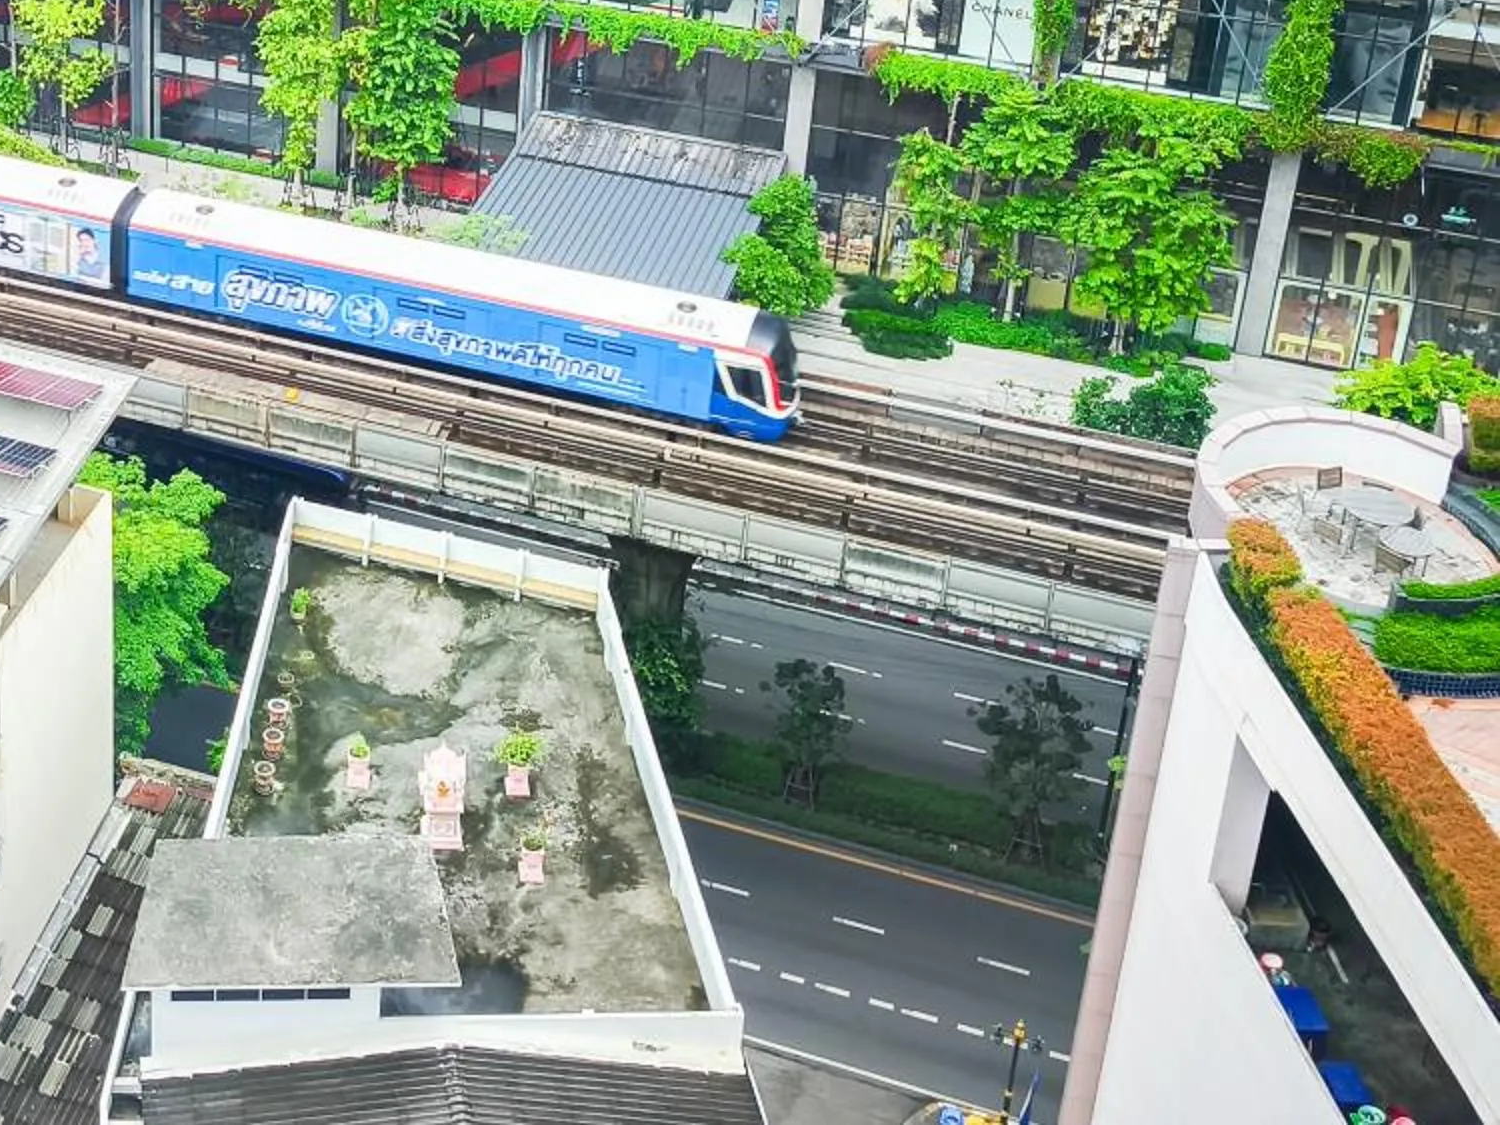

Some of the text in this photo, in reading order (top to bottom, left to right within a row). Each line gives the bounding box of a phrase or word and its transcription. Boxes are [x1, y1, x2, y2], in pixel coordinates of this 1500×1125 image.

[971, 1, 1033, 21] CHANEL
[225, 272, 337, 315] สุขภาพ
